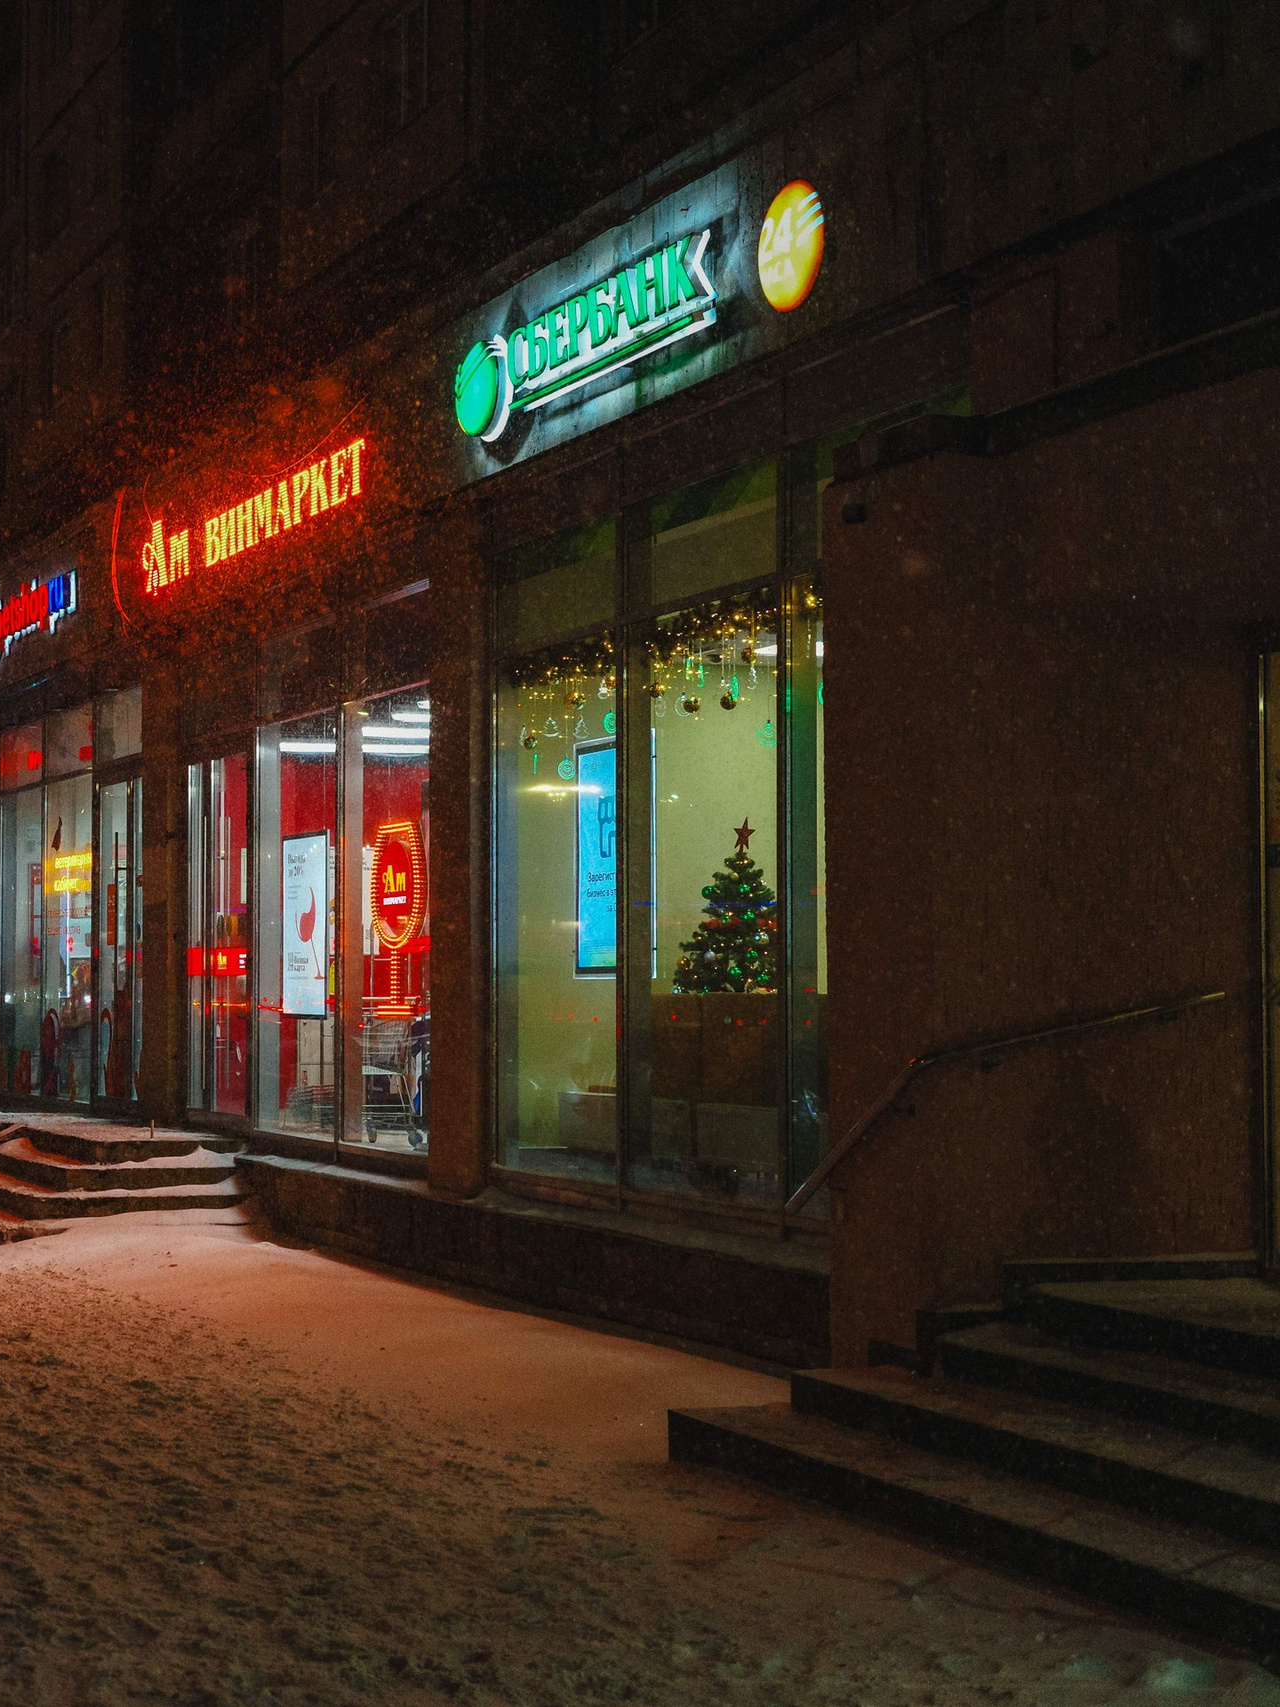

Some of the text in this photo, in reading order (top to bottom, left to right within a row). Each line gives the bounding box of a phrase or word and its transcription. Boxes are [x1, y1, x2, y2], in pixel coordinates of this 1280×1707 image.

[759, 207, 793, 266] 24
[507, 234, 699, 387] СБЕРБАНК
[142, 438, 366, 596] Ам ВИНМАРКЕТ
[382, 865, 406, 894] Ам
